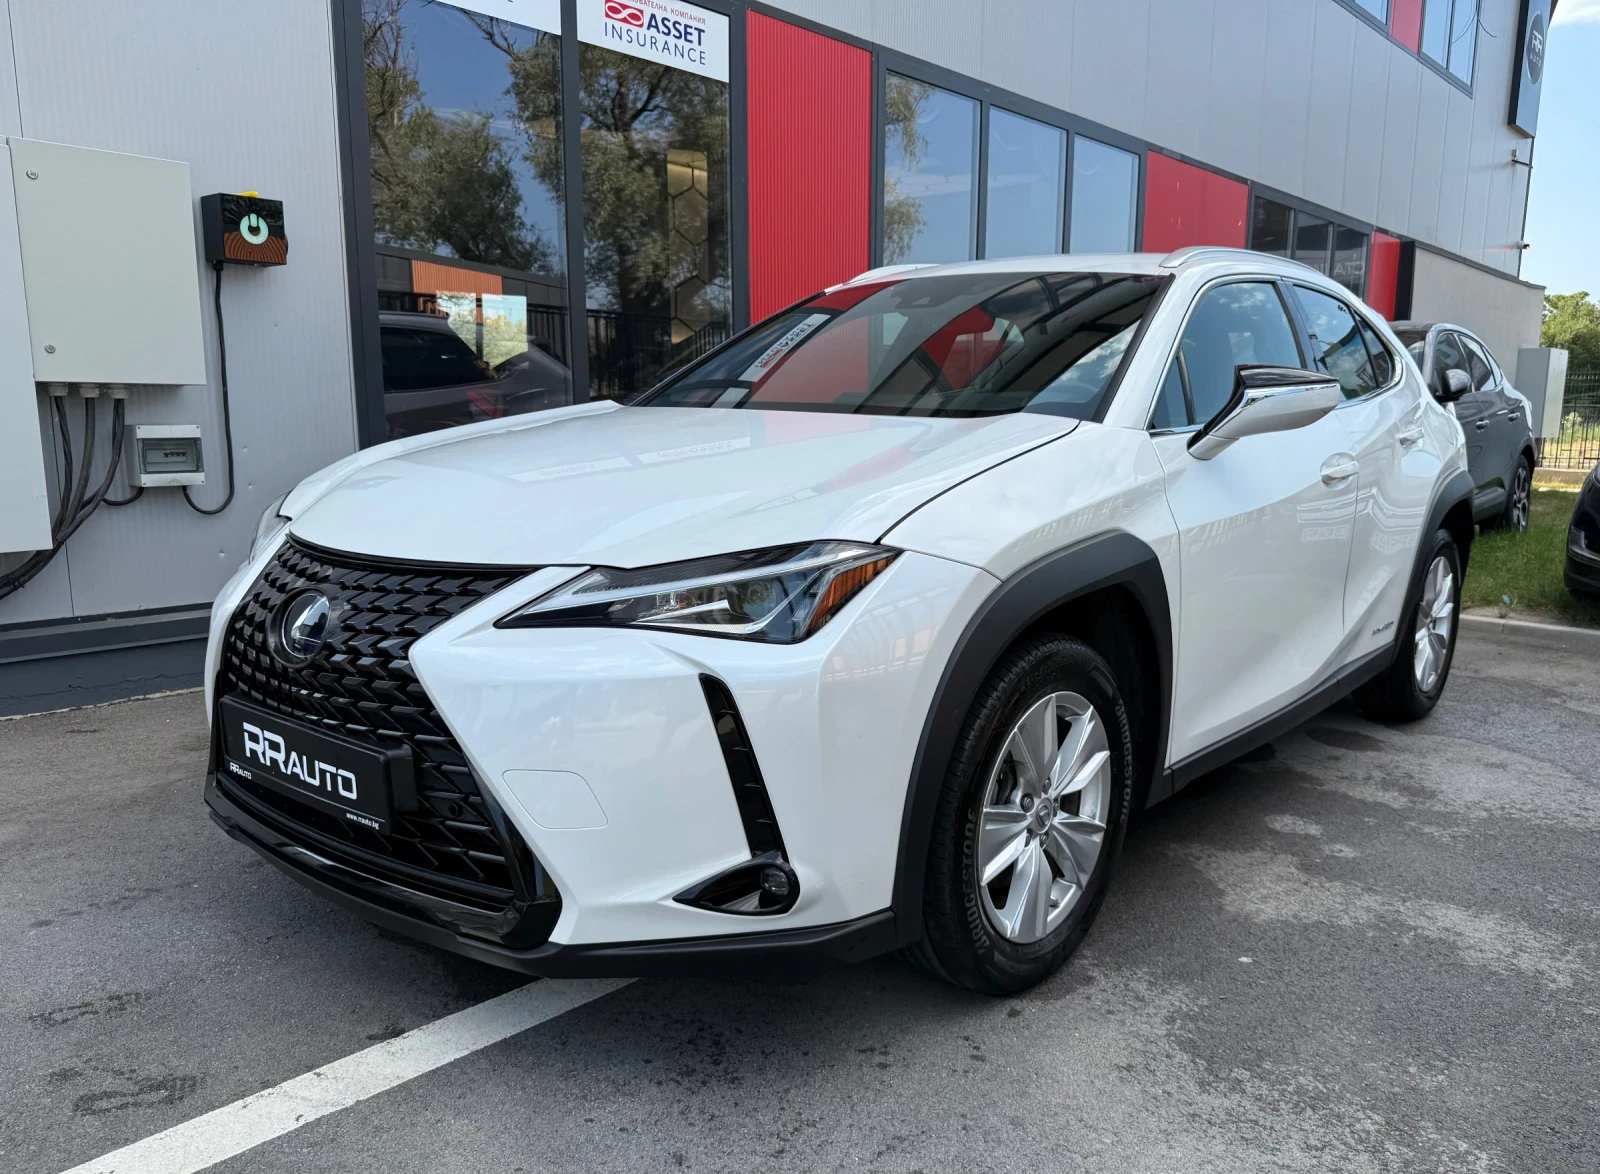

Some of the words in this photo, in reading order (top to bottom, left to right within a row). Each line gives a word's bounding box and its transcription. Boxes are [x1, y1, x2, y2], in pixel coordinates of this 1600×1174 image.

[646, 13, 706, 46] ASSET
[670, 8, 706, 25] КОМПАНИЯ
[604, 22, 706, 65] INSURANCE
[1114, 699, 1132, 824] BRIDGESTONE
[962, 807, 990, 955] BRIDGESTONE
